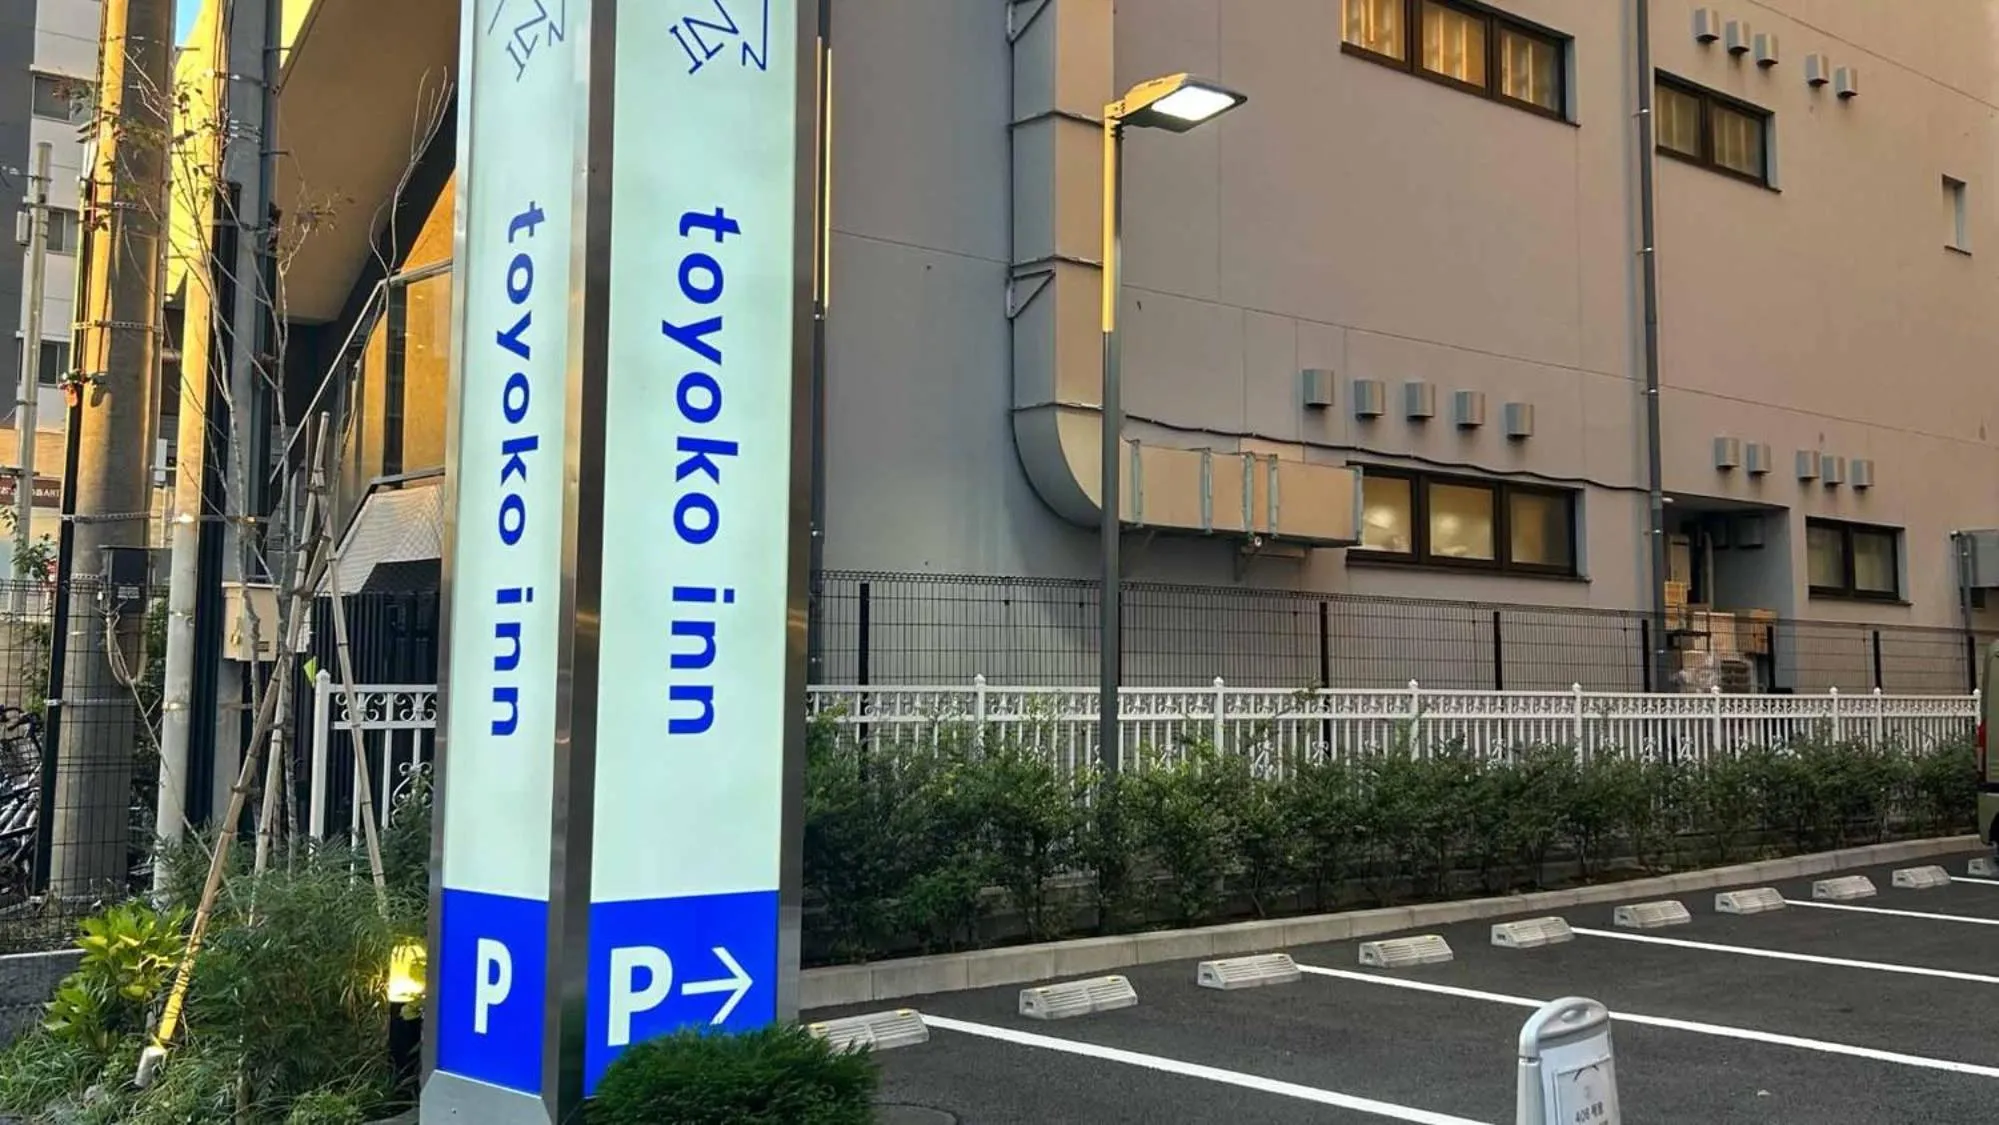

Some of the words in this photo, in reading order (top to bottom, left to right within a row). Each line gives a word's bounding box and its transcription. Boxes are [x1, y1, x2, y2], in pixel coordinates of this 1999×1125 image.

[496, 201, 545, 546] toyoko
[661, 207, 742, 545] toyoko
[491, 586, 534, 736] inn
[668, 586, 735, 735] inn
[474, 937, 513, 1035] P
[607, 945, 674, 1047] P
